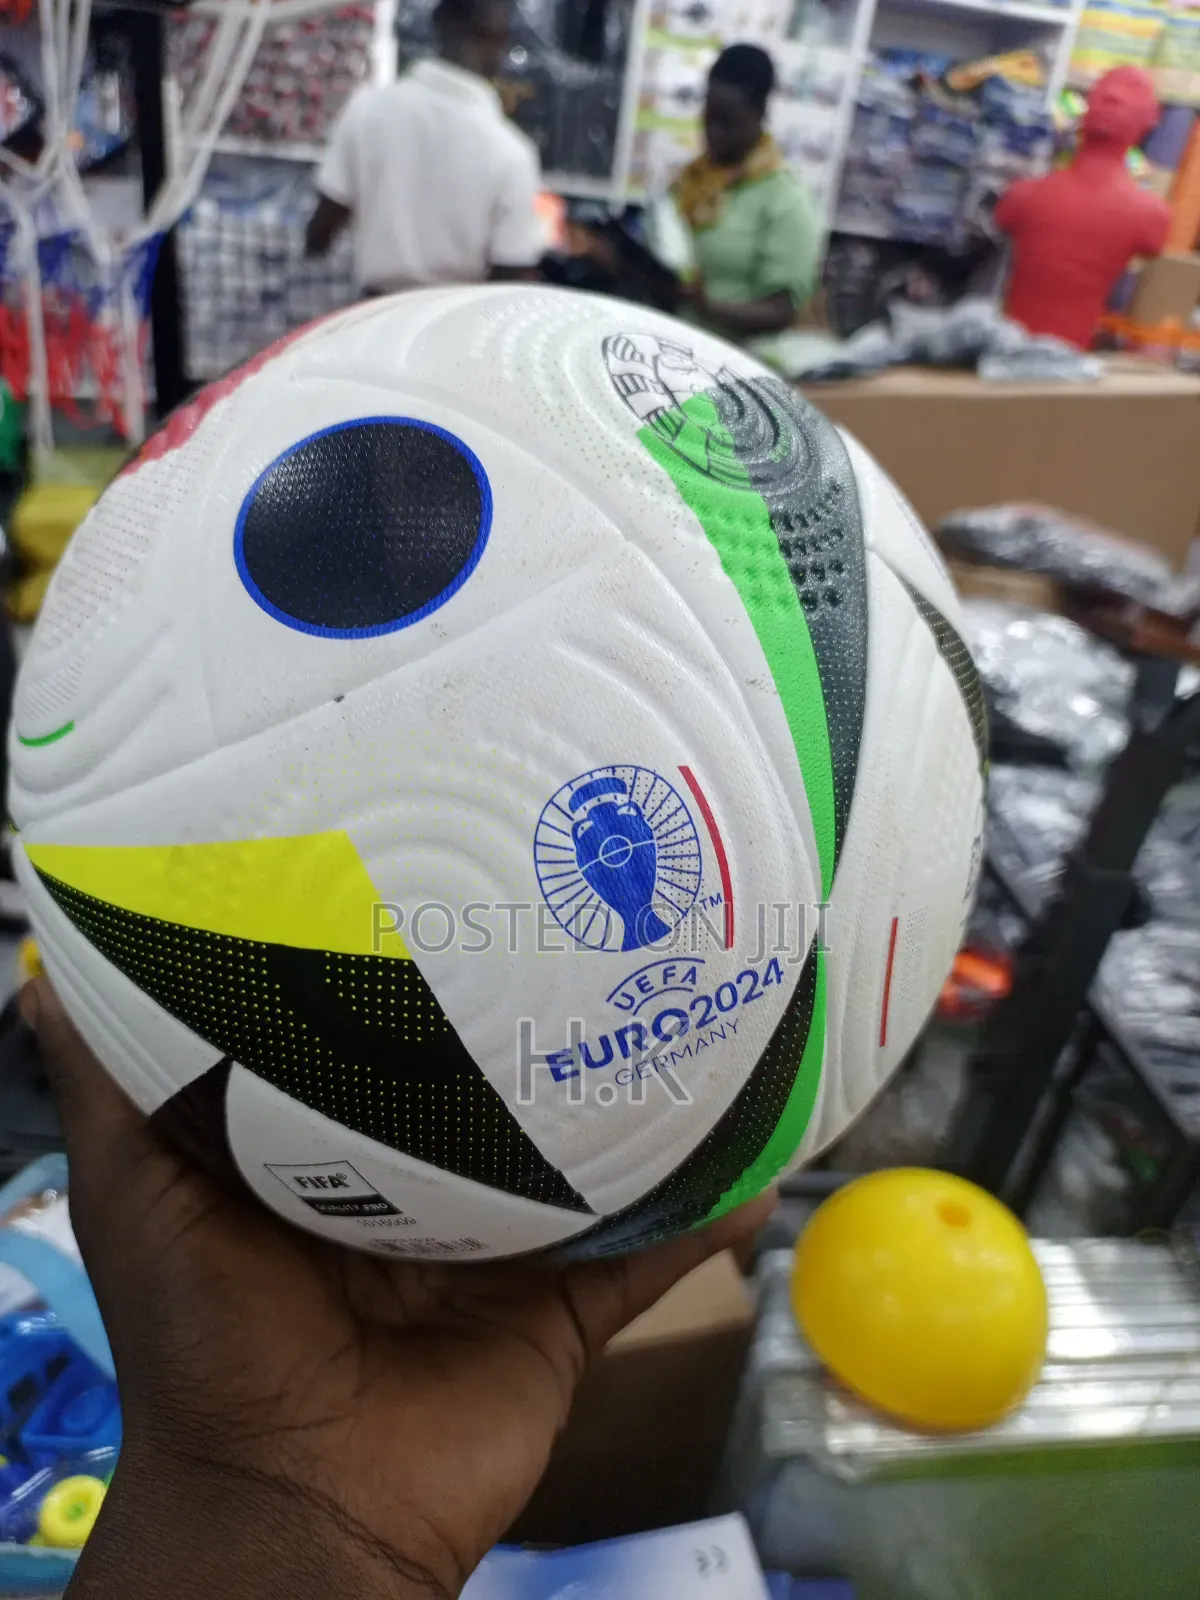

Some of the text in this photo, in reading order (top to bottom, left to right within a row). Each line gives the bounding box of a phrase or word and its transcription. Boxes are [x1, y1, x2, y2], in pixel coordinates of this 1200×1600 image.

[613, 961, 698, 1012] UEFA
[614, 1017, 741, 1087] GERMANY
[362, 1202, 389, 1213] PRO
